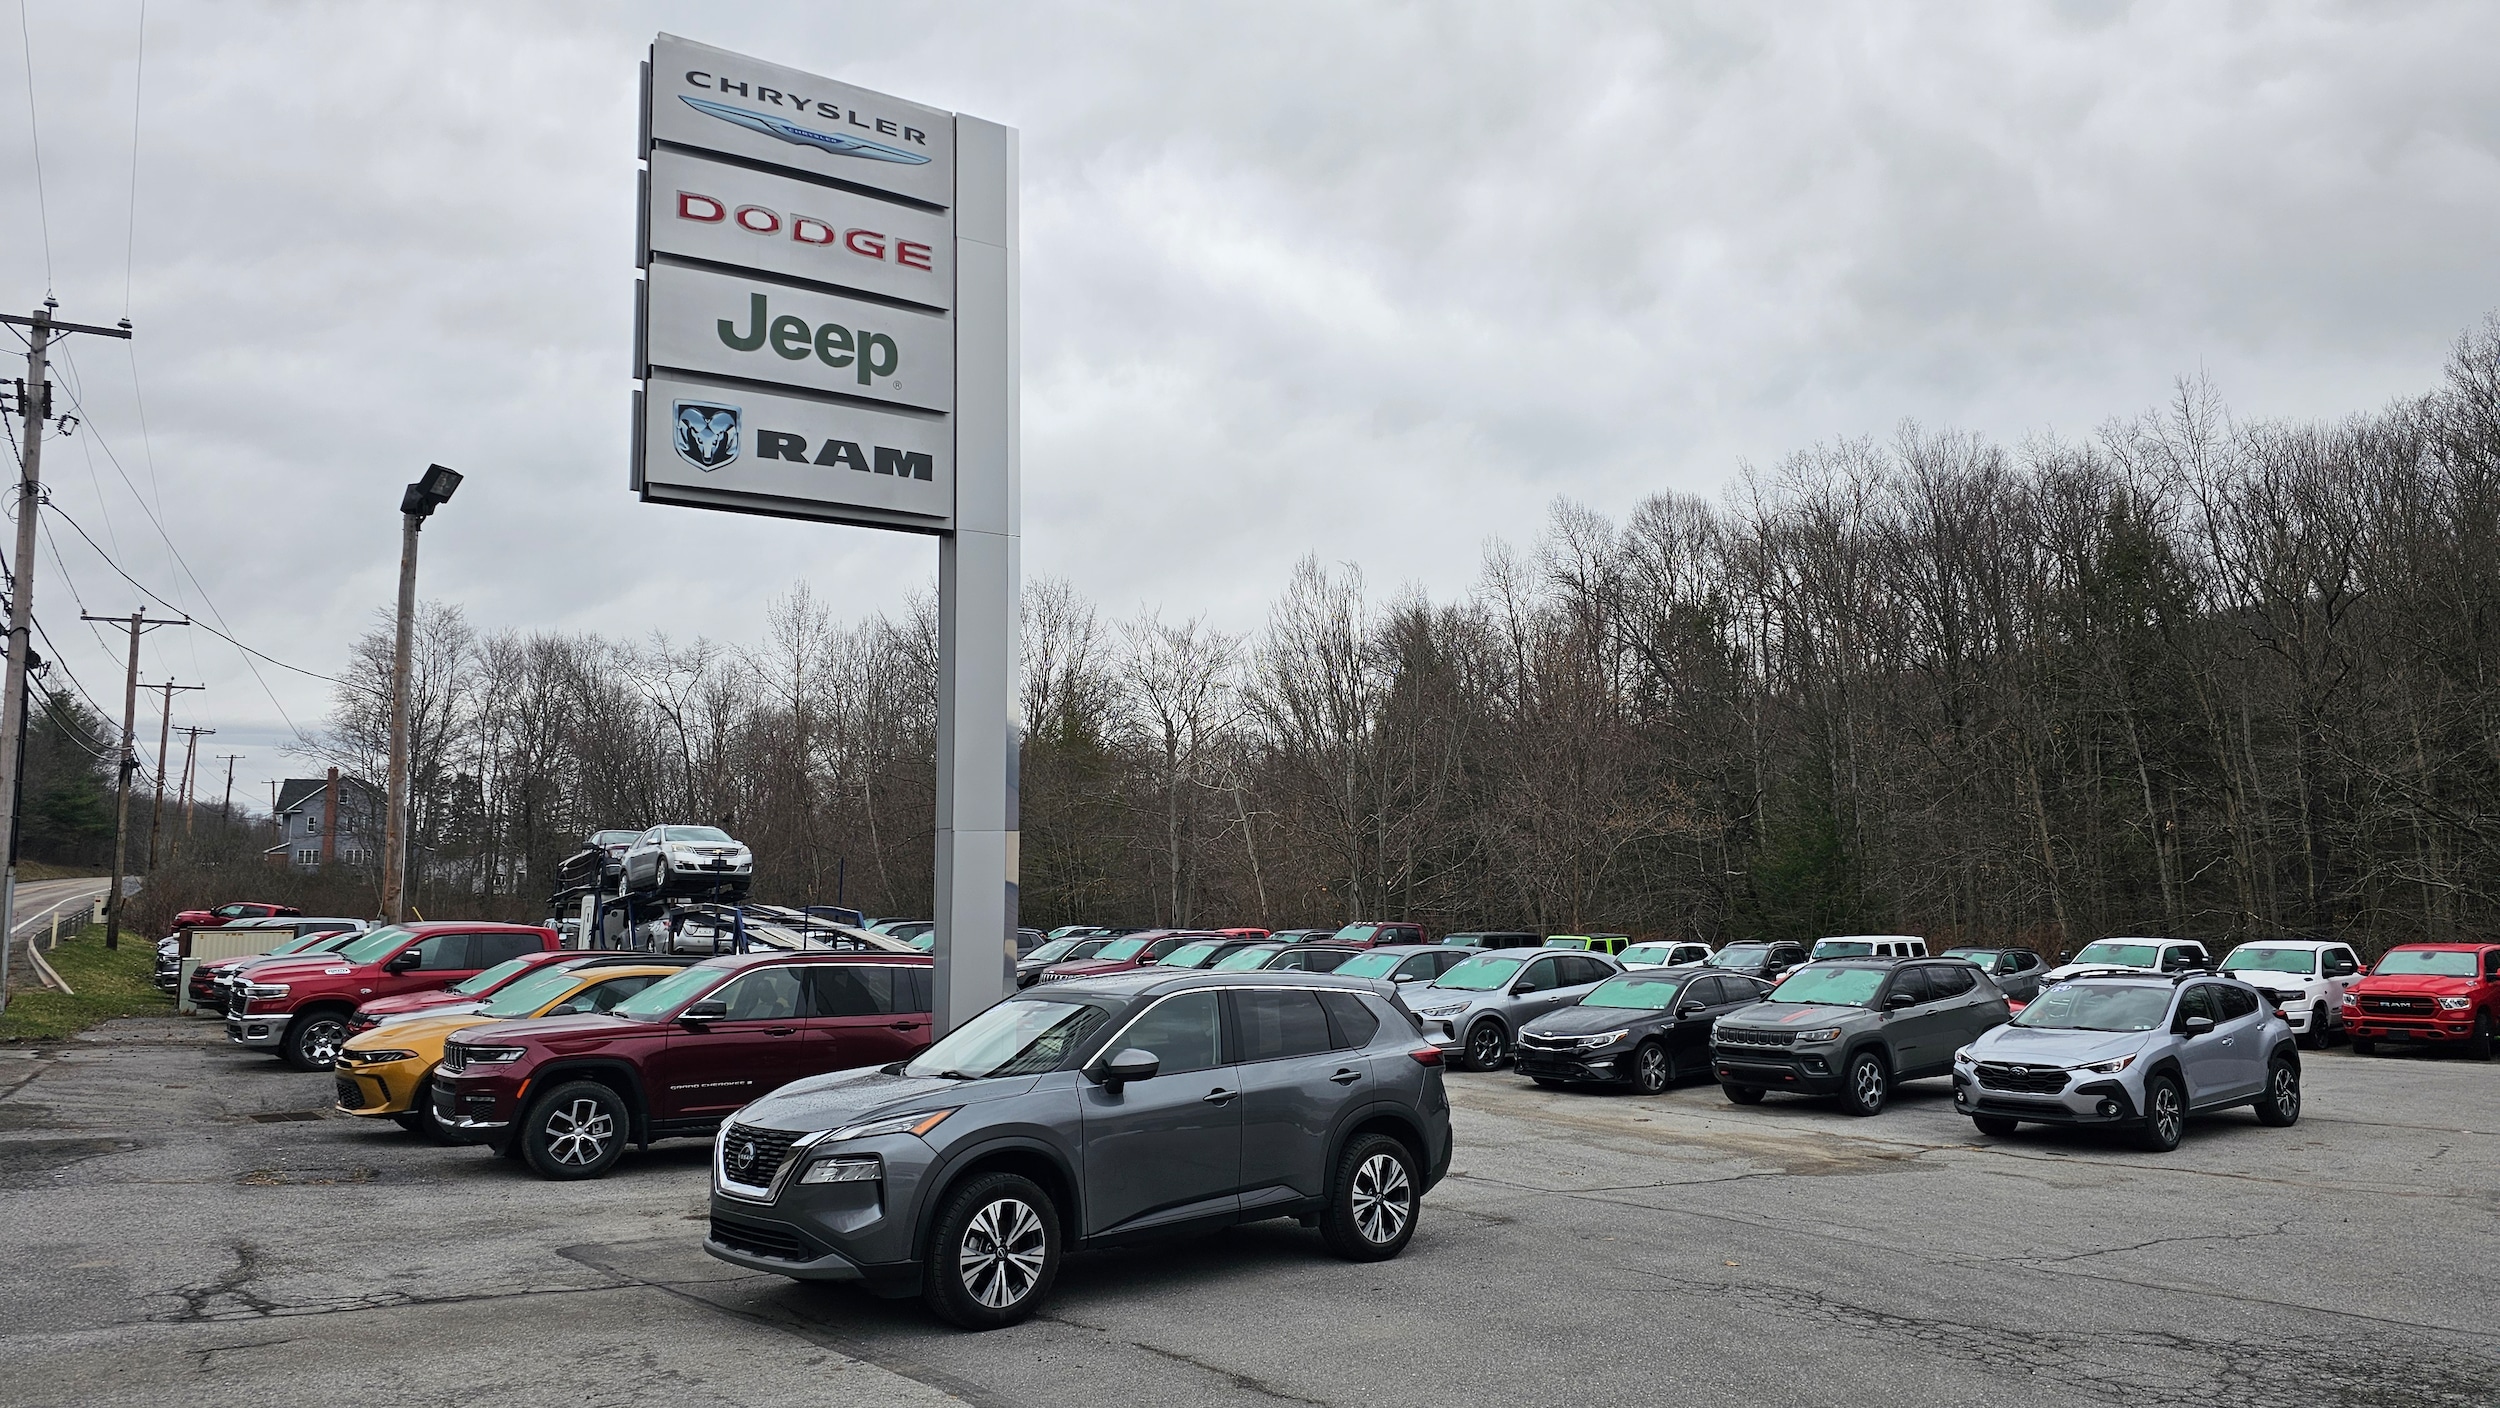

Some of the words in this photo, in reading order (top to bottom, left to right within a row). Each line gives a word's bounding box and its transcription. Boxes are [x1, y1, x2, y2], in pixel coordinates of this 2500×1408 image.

[685, 70, 927, 147] CHRYSLER
[788, 128, 837, 143] CHRYSLER
[677, 190, 933, 273] DODGE
[717, 292, 899, 387] Jeep
[757, 429, 933, 482] RAM
